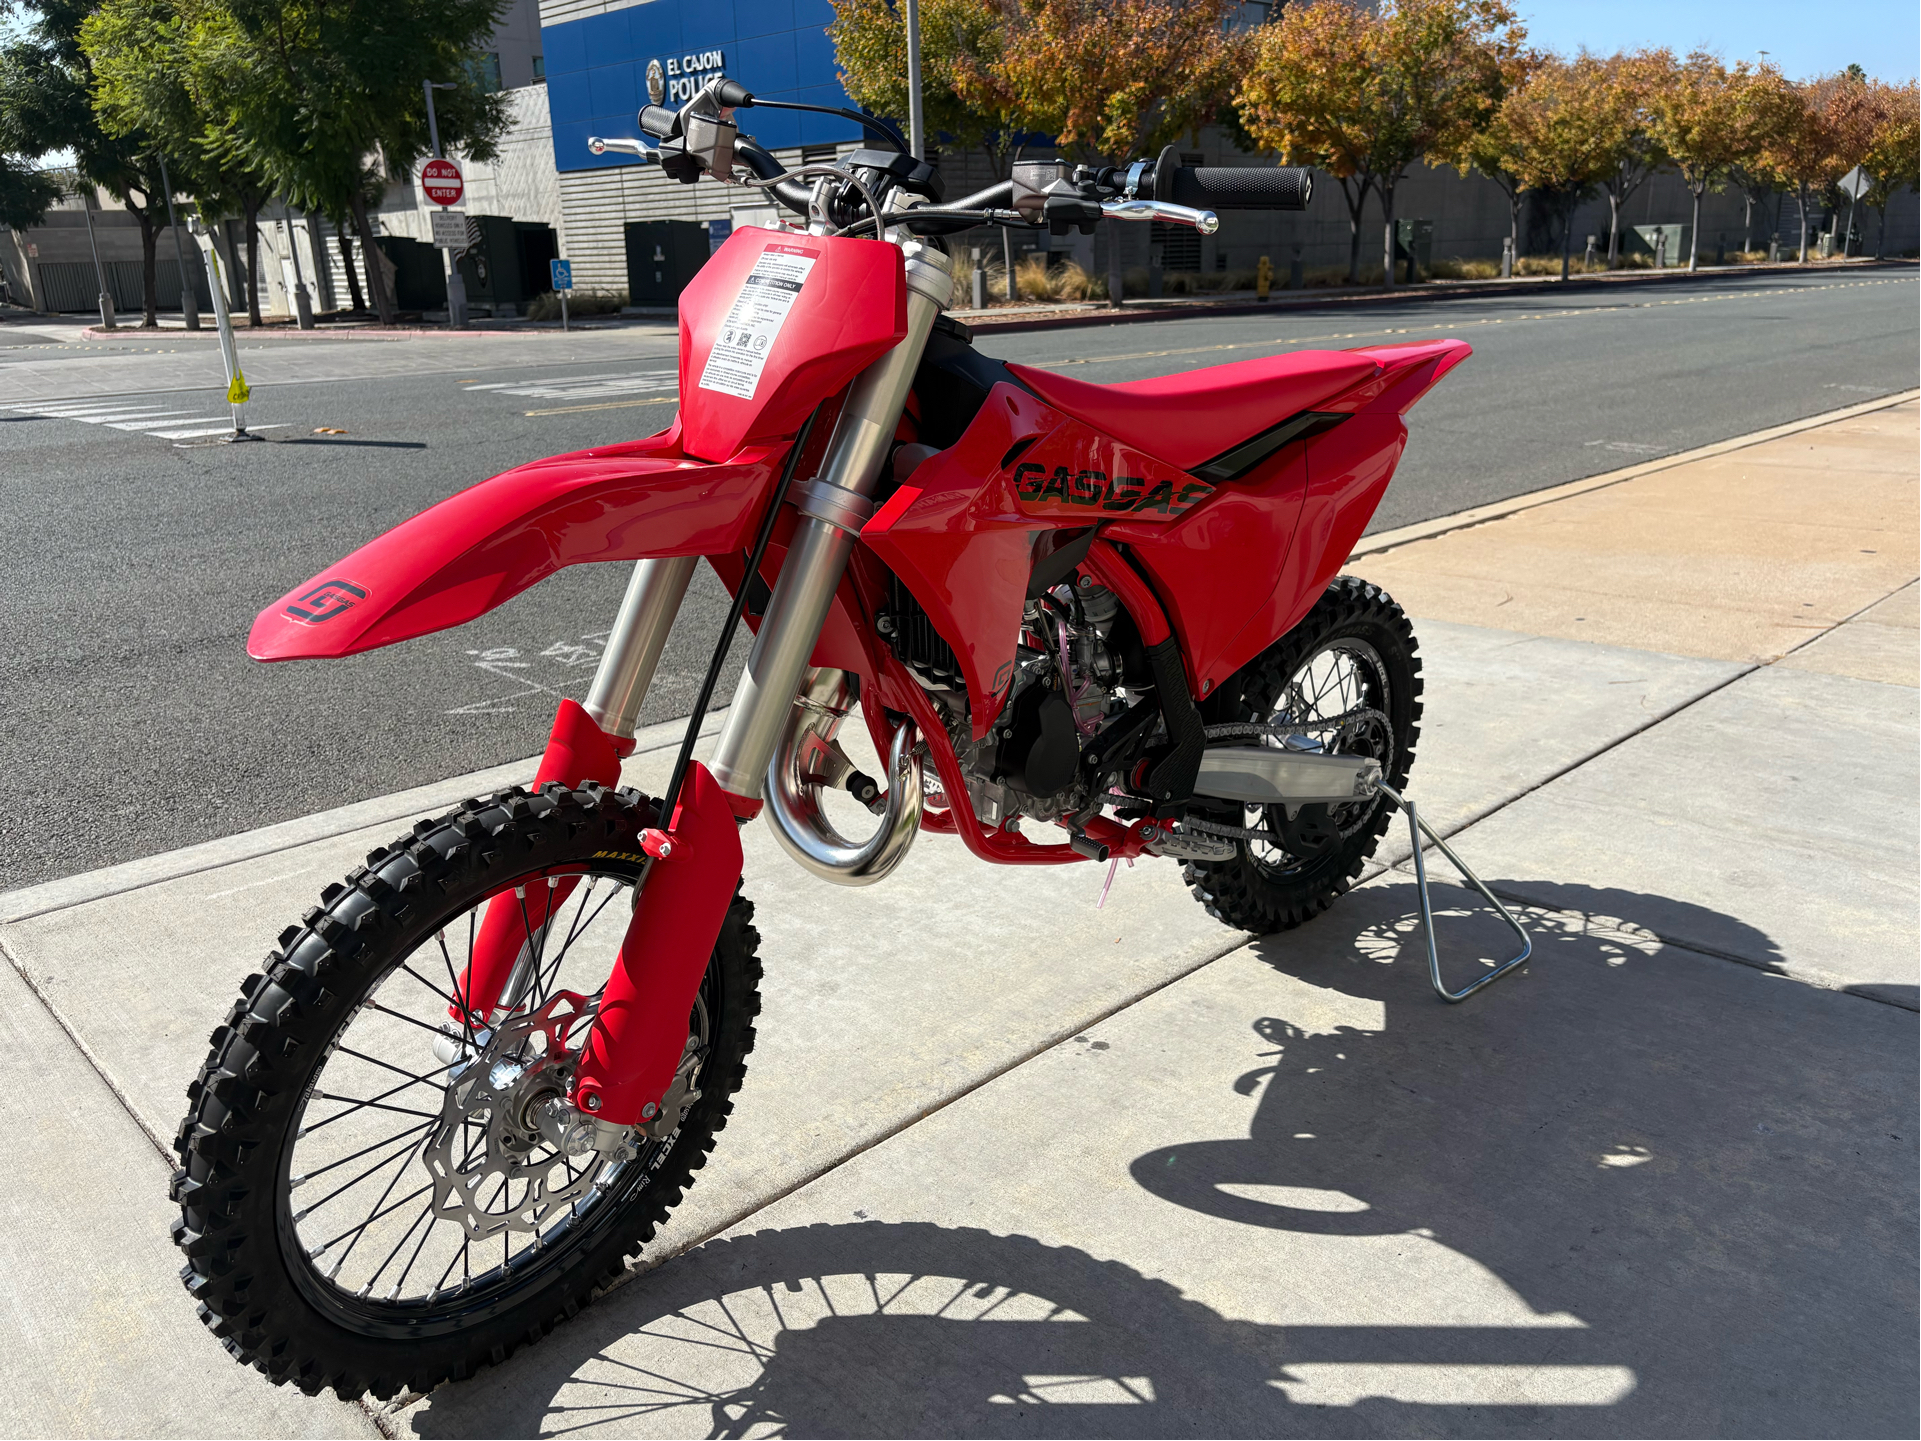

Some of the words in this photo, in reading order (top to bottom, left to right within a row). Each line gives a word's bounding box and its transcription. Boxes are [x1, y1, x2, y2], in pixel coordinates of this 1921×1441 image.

[667, 59, 682, 75] EL
[683, 51, 722, 73] CAJON
[426, 168, 438, 176] DO
[441, 168, 456, 177] NOT
[431, 189, 456, 197] ENTER
[1013, 462, 1215, 515] GASGAS
[323, 591, 356, 608] GASGAS
[323, 1004, 366, 1058] EXCEL
[650, 1127, 682, 1170] EXCEL
